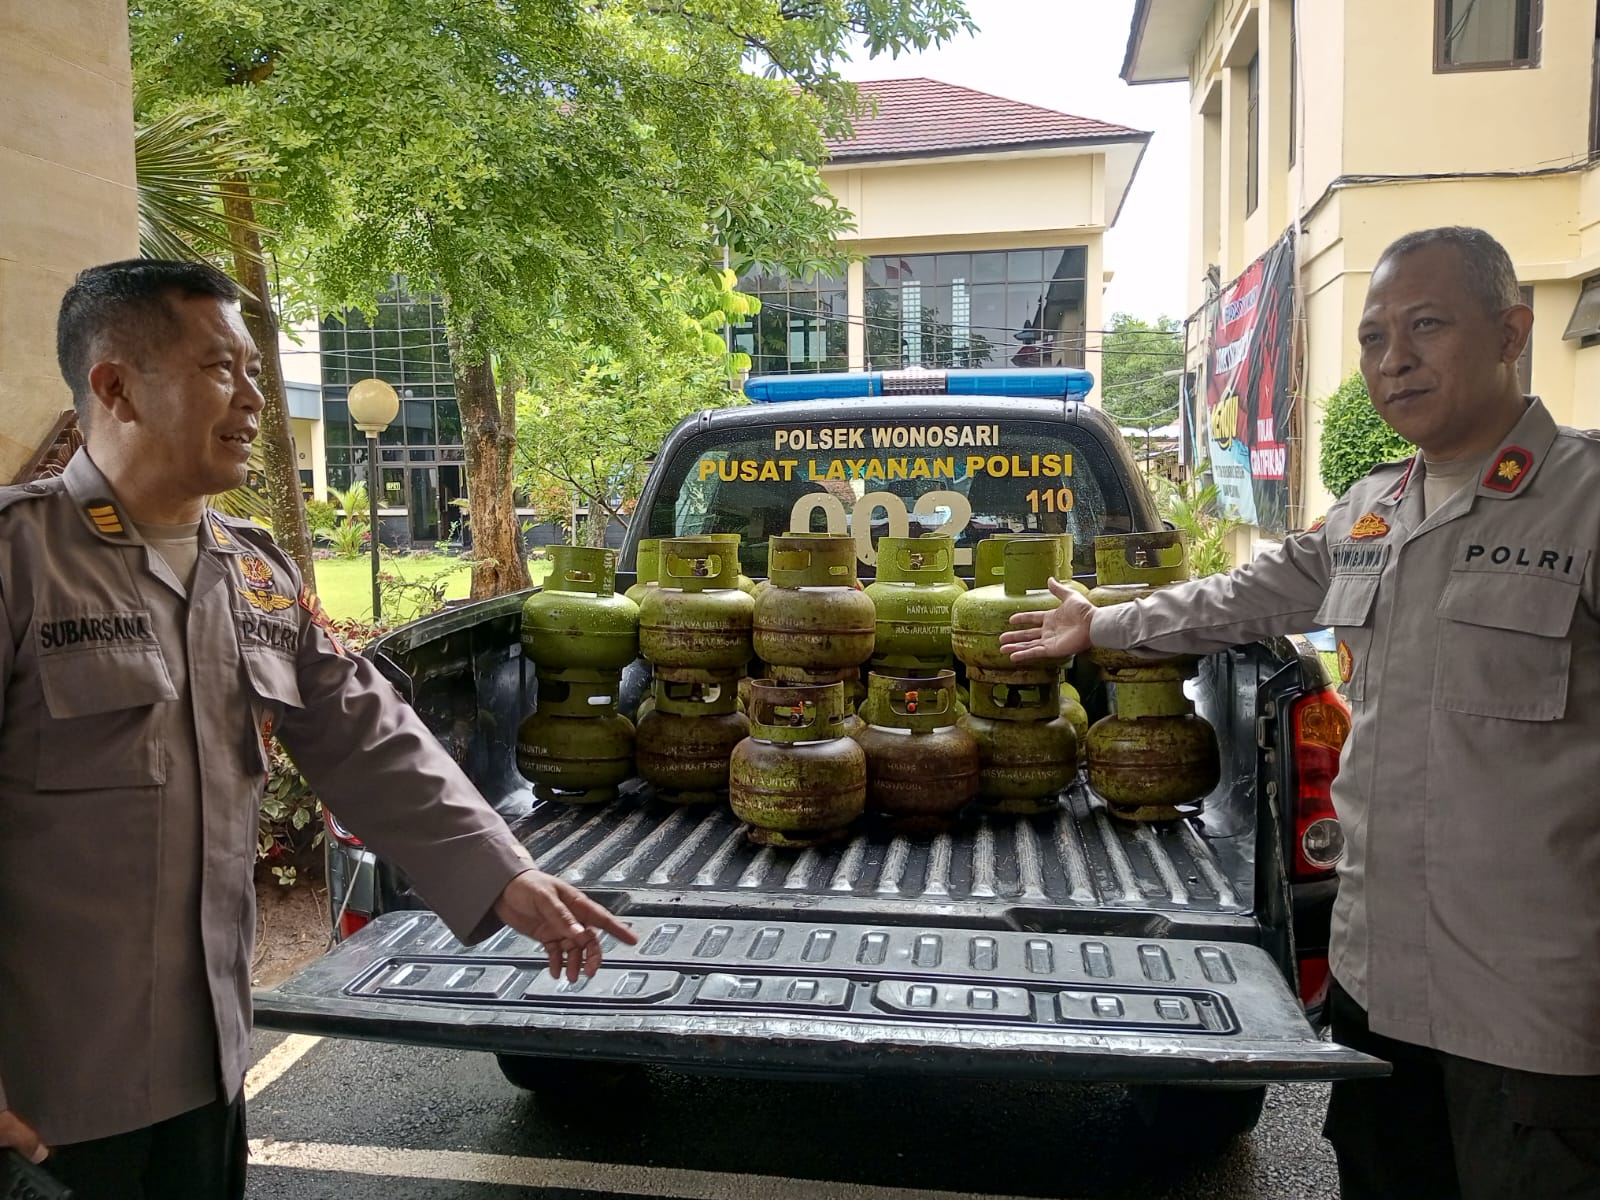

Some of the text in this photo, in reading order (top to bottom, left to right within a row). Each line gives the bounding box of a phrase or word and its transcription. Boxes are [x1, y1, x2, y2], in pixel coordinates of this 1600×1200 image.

[775, 424, 999, 451] POLSEK WONOSARI
[698, 454, 1073, 482] PUSAT LAYANAN POLISI
[1025, 488, 1074, 513] 110
[790, 491, 972, 567] 002
[1465, 544, 1574, 574] POLRI
[40, 616, 152, 648] SUBARSANA
[242, 619, 298, 651] POLRI
